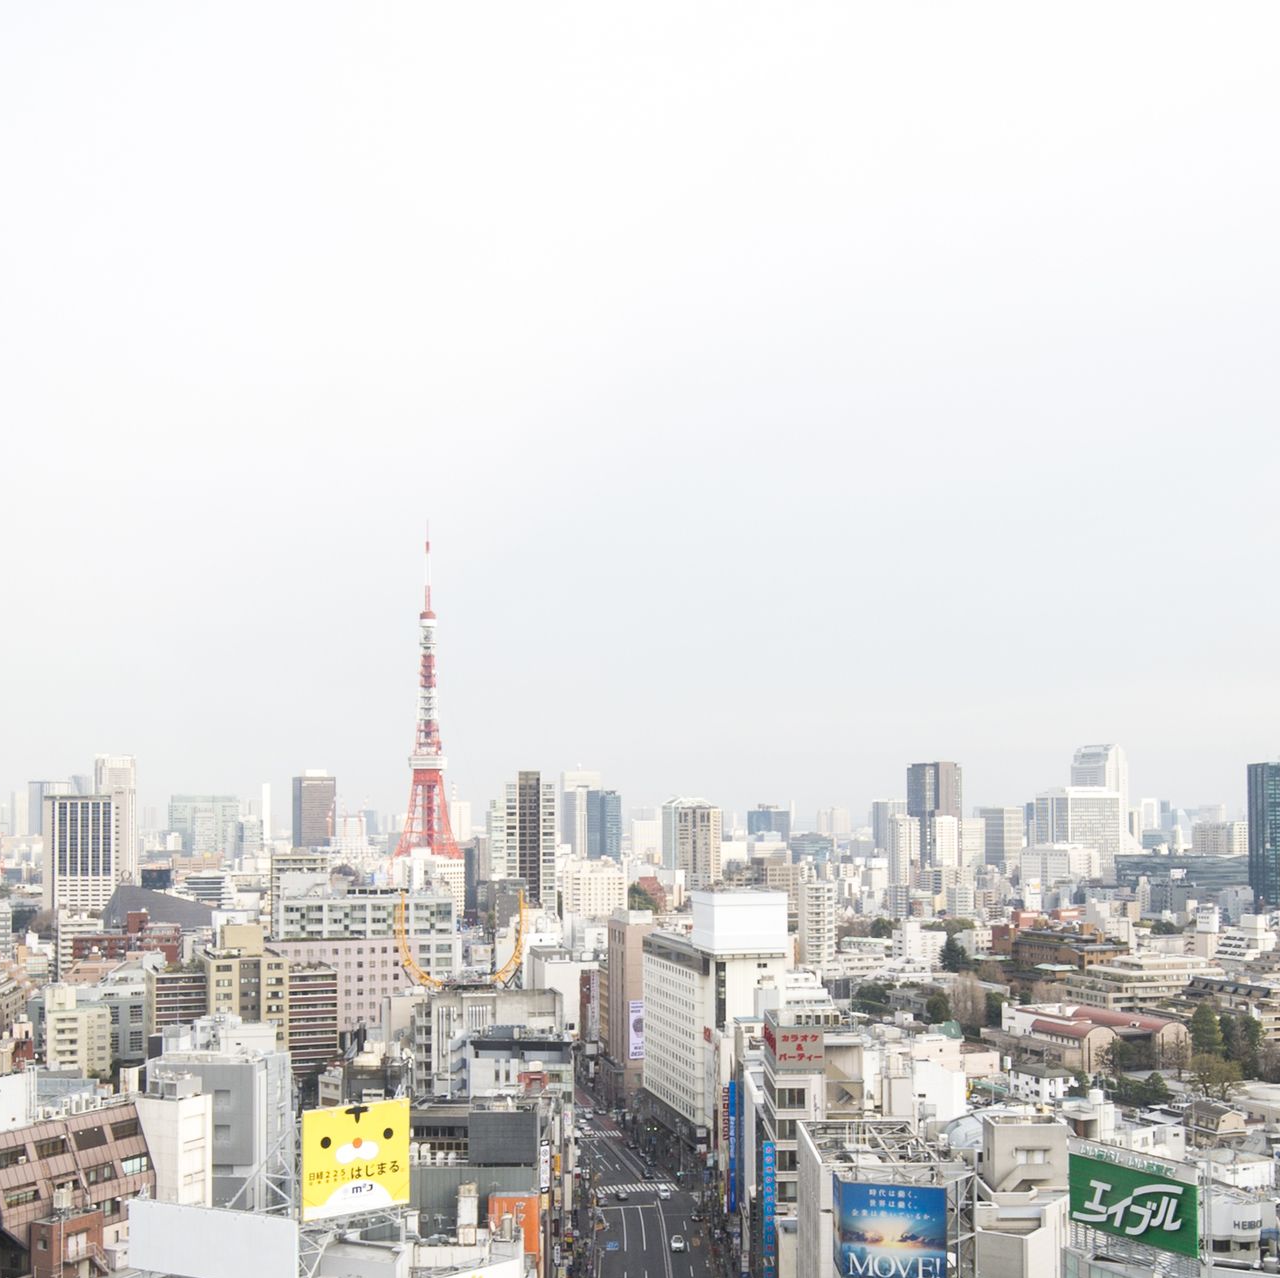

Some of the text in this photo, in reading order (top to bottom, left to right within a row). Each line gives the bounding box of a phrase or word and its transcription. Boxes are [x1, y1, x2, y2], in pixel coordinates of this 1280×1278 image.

[781, 1034, 819, 1043] カラオケ
[795, 1043, 804, 1051] &
[778, 1052, 823, 1062] パーティー
[868, 1188, 918, 1199] 時代は動く。
[869, 1199, 918, 1210] 世界は動く。
[1072, 1179, 1184, 1236] エイブル
[851, 1208, 936, 1222] 企業は動いているか。
